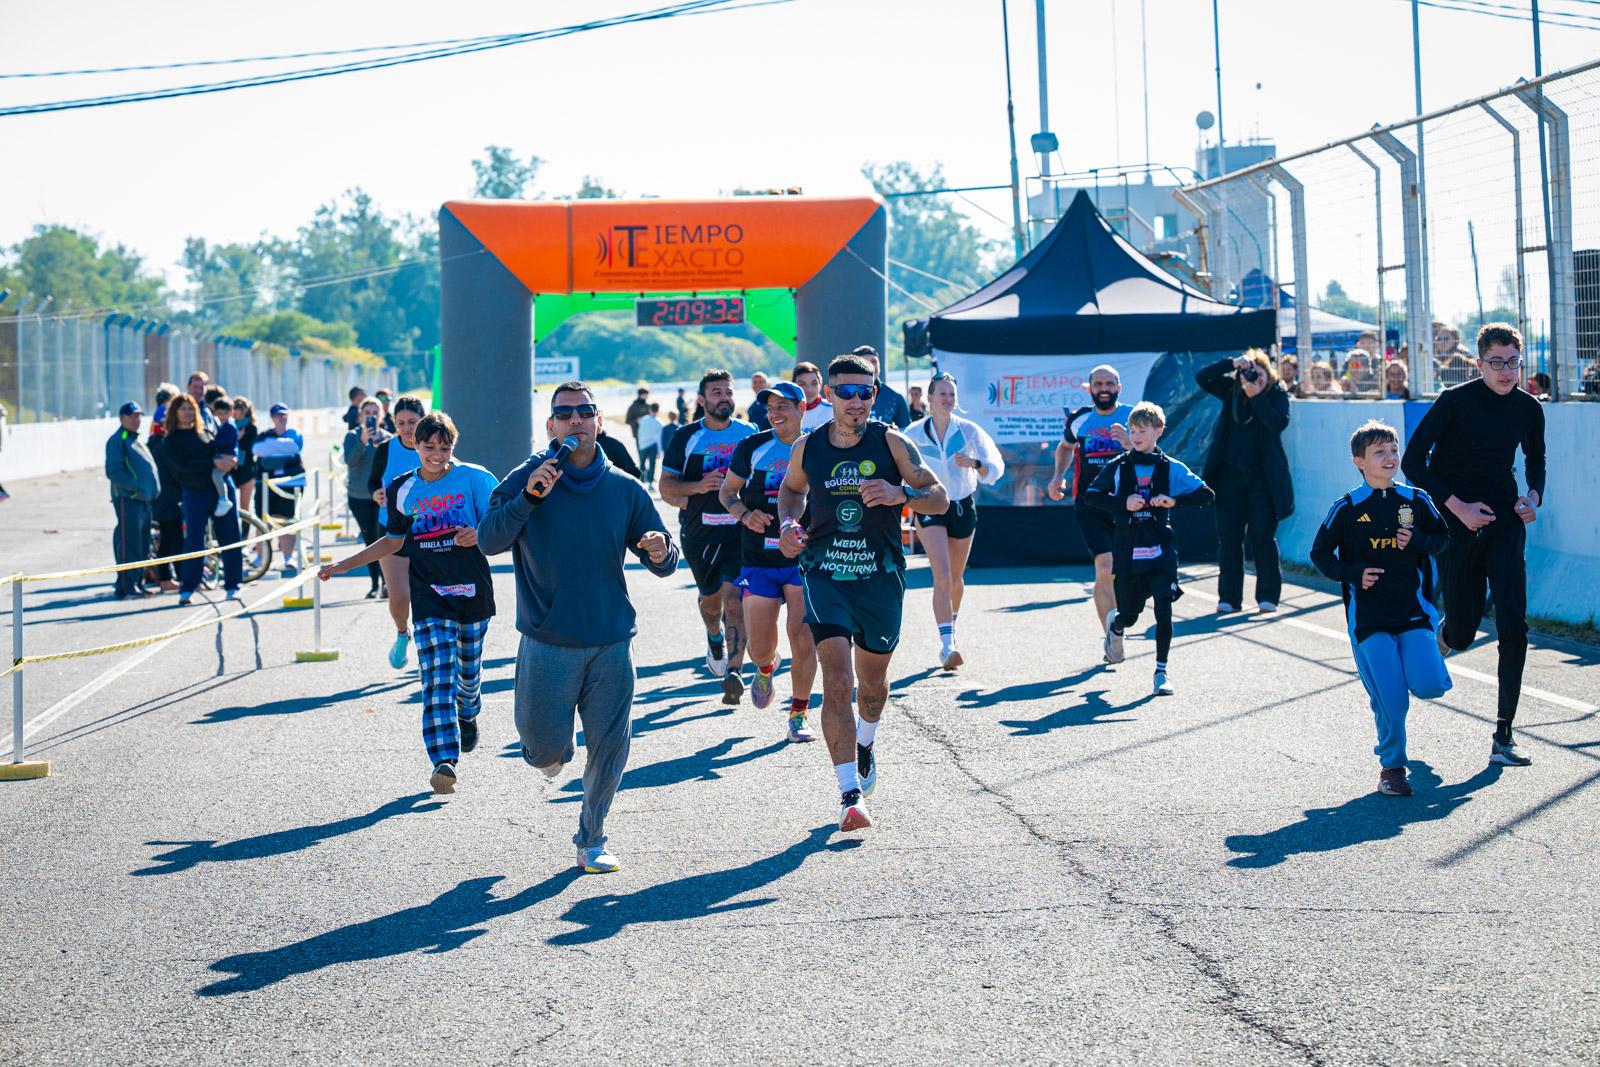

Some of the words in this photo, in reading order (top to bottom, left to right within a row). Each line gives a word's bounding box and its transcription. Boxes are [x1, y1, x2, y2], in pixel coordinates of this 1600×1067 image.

[614, 224, 743, 267] TIEMPO
[635, 231, 744, 268] EXACTO
[653, 299, 742, 325] 2:09:32
[863, 462, 872, 474] 3
[841, 508, 857, 521] SF
[833, 538, 867, 548] MEDIA
[825, 549, 875, 562] MARATÓN
[819, 561, 878, 574] NOCTURNA
